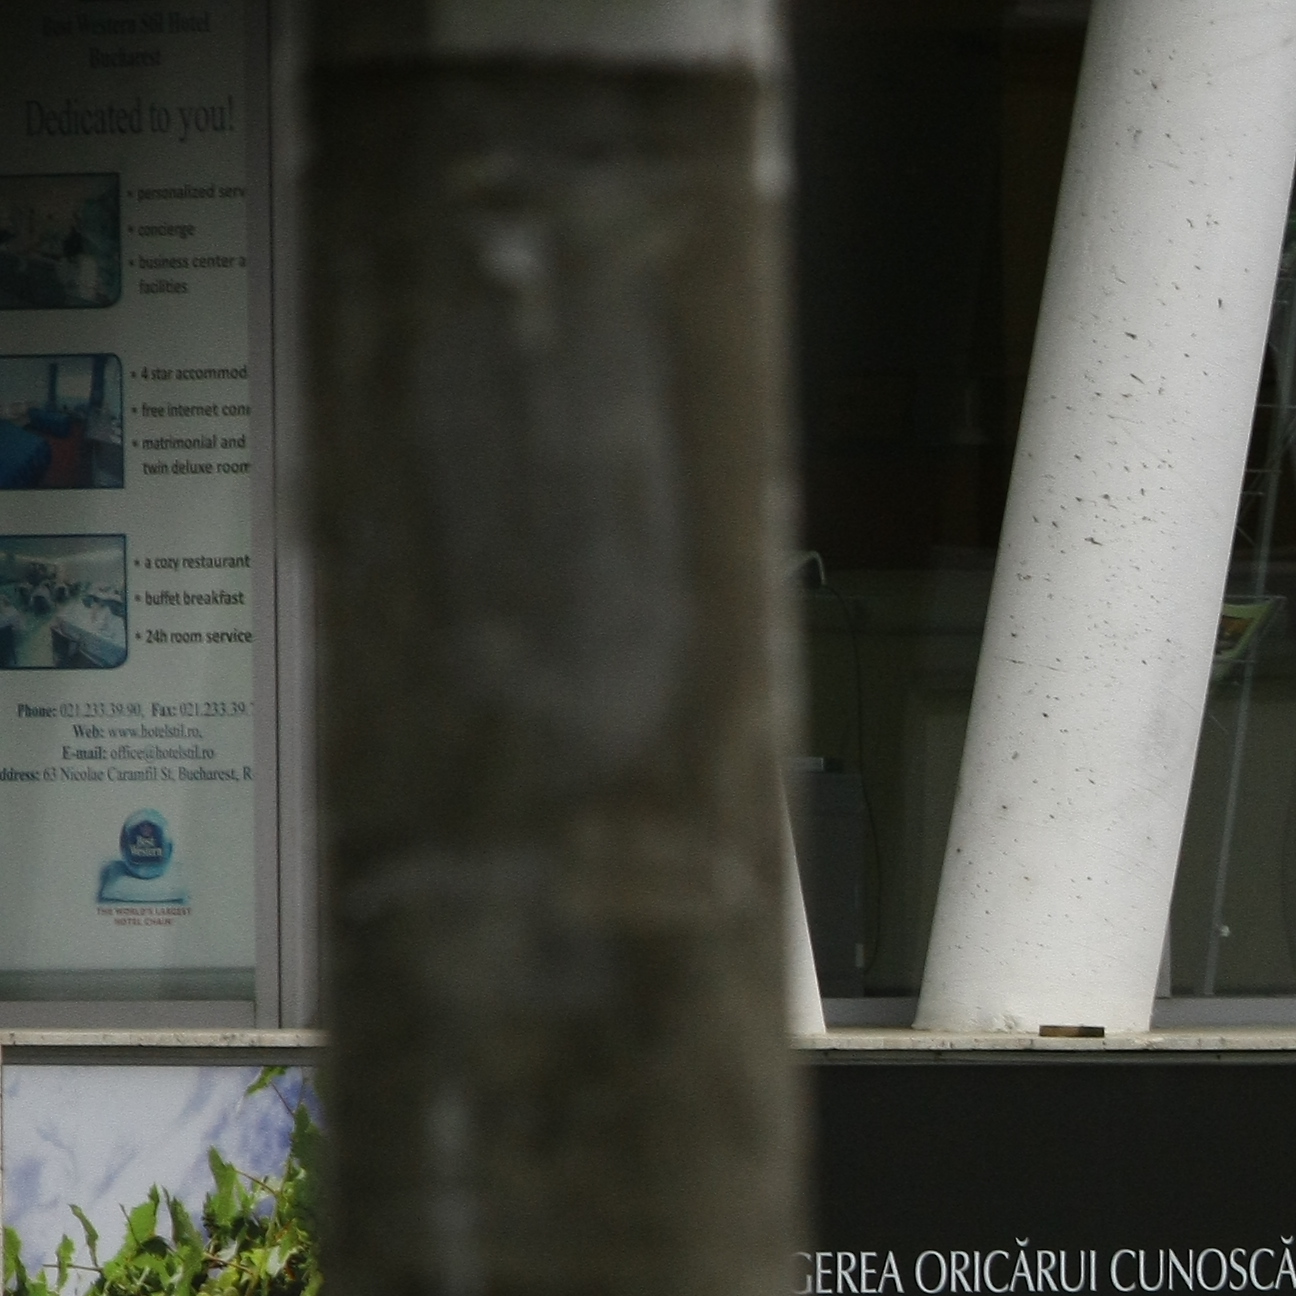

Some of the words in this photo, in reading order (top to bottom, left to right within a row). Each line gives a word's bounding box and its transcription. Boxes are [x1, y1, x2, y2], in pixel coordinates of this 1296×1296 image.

[26, 97, 144, 136] Dedicated
[150, 101, 171, 134] to
[177, 94, 235, 143] you!
[137, 184, 216, 202] personalized
[138, 223, 197, 240] concierge
[138, 254, 190, 270] business
[192, 255, 236, 269] center
[140, 278, 190, 295] facilities
[141, 366, 149, 380] 4
[151, 368, 174, 381] star
[141, 401, 165, 418] free
[167, 401, 220, 418] internet
[142, 433, 218, 450] matrimonial
[220, 433, 247, 450] and
[142, 460, 169, 475] twin
[171, 459, 214, 475] deluxe
[144, 556, 152, 570] a
[154, 556, 180, 573] cozy
[182, 554, 252, 570] restaurant
[144, 589, 182, 607] buffet
[183, 589, 246, 607] breakfast
[145, 628, 168, 644] 24h
[170, 631, 203, 644] room
[205, 627, 253, 644] service
[17, 703, 58, 718] Phone:
[151, 702, 178, 718] Fax:
[72, 724, 106, 740] Web:
[61, 745, 108, 761] E-mail:
[42, 767, 57, 782] 63
[60, 766, 104, 782] Nicolae
[106, 766, 158, 782] Caramfil
[914, 1236, 1099, 1295] ORICĂRUI
